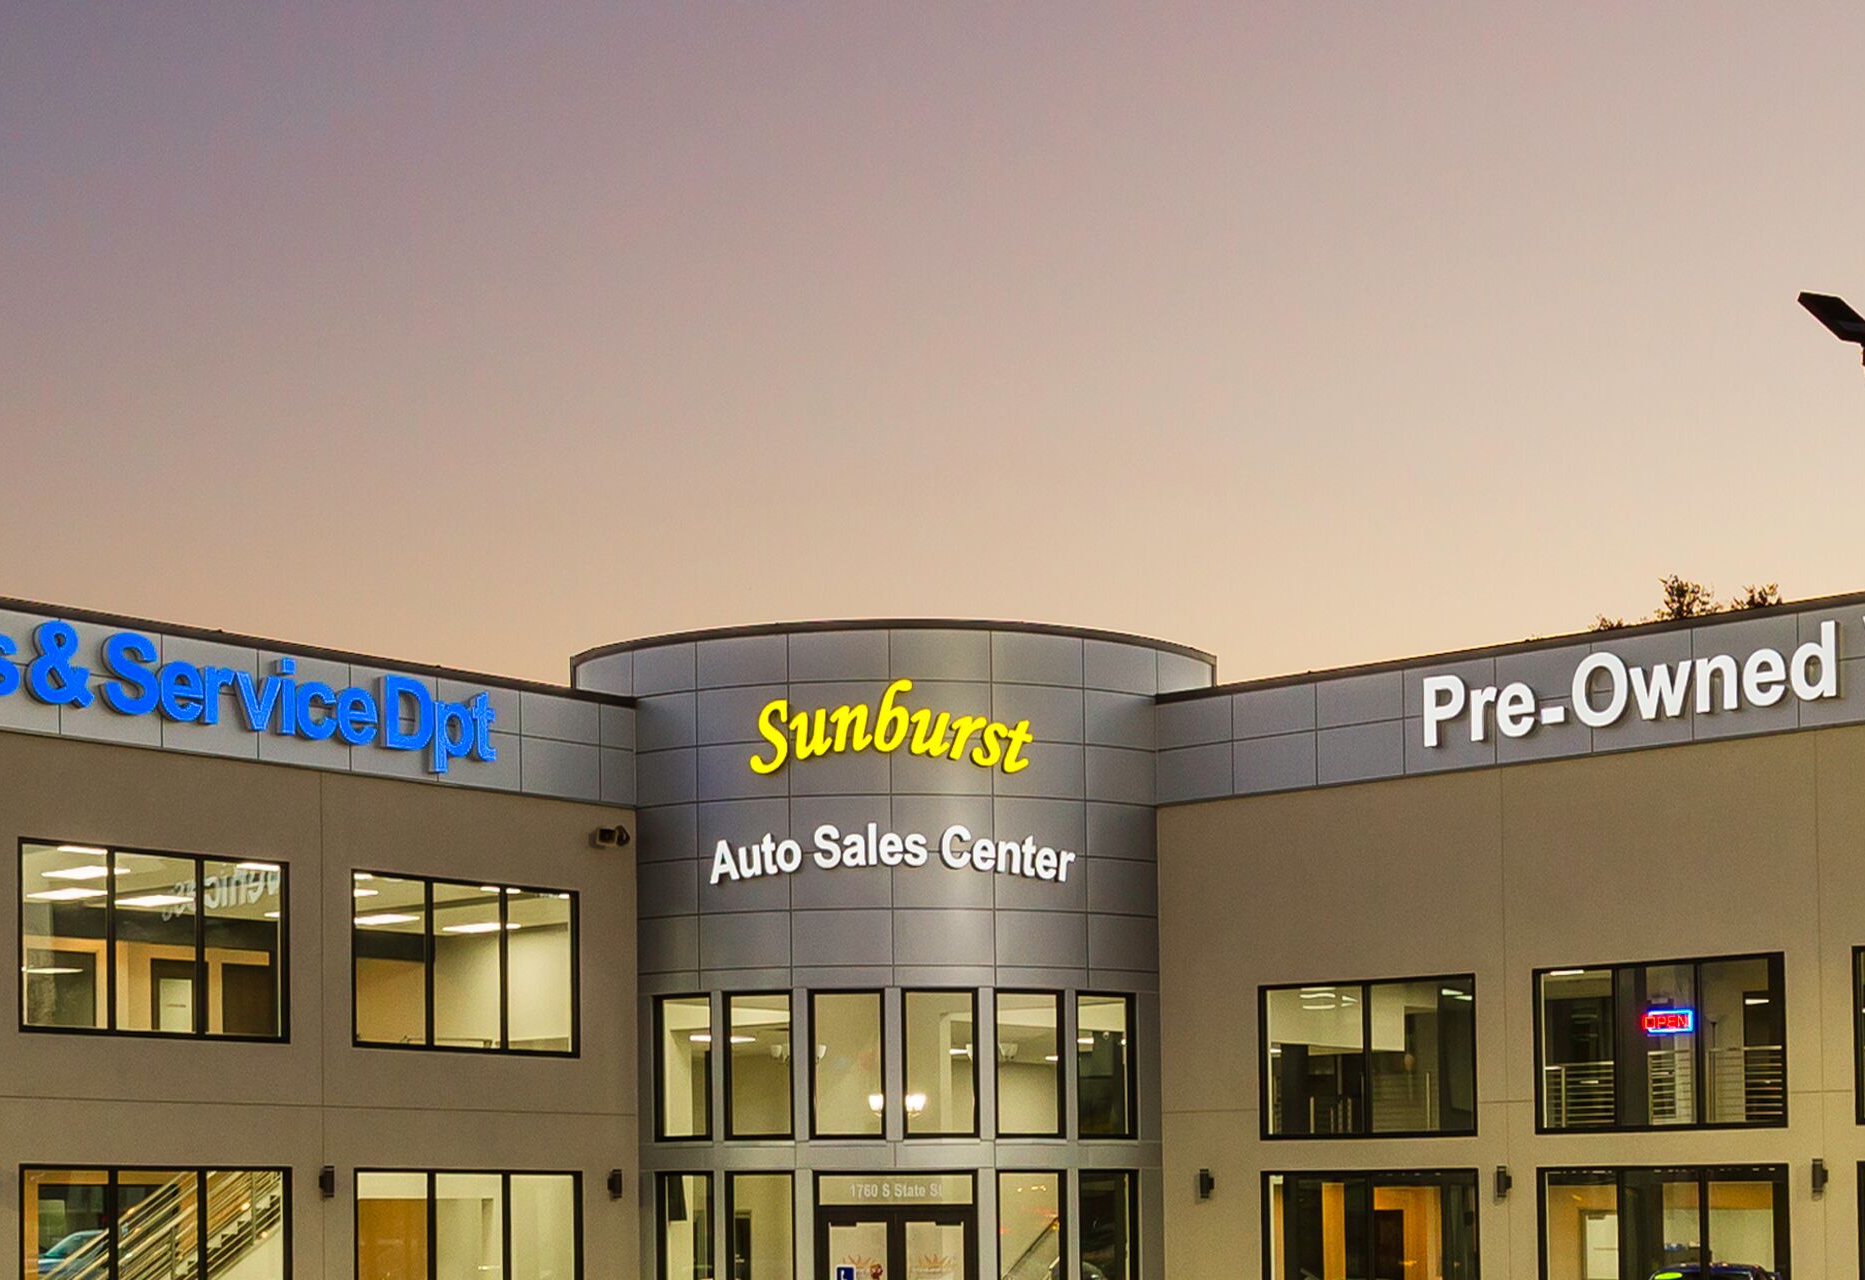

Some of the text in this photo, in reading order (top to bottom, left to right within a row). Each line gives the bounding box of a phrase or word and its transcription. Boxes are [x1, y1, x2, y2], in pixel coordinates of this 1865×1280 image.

[29, 619, 96, 709] &
[1423, 620, 1836, 747] Pre-Owned
[749, 677, 1035, 775] Sunburst
[709, 822, 1076, 884] Auto Sales Center
[1644, 1014, 1688, 1029] OPEN
[882, 1183, 891, 1198] S
[894, 1183, 926, 1198] State
